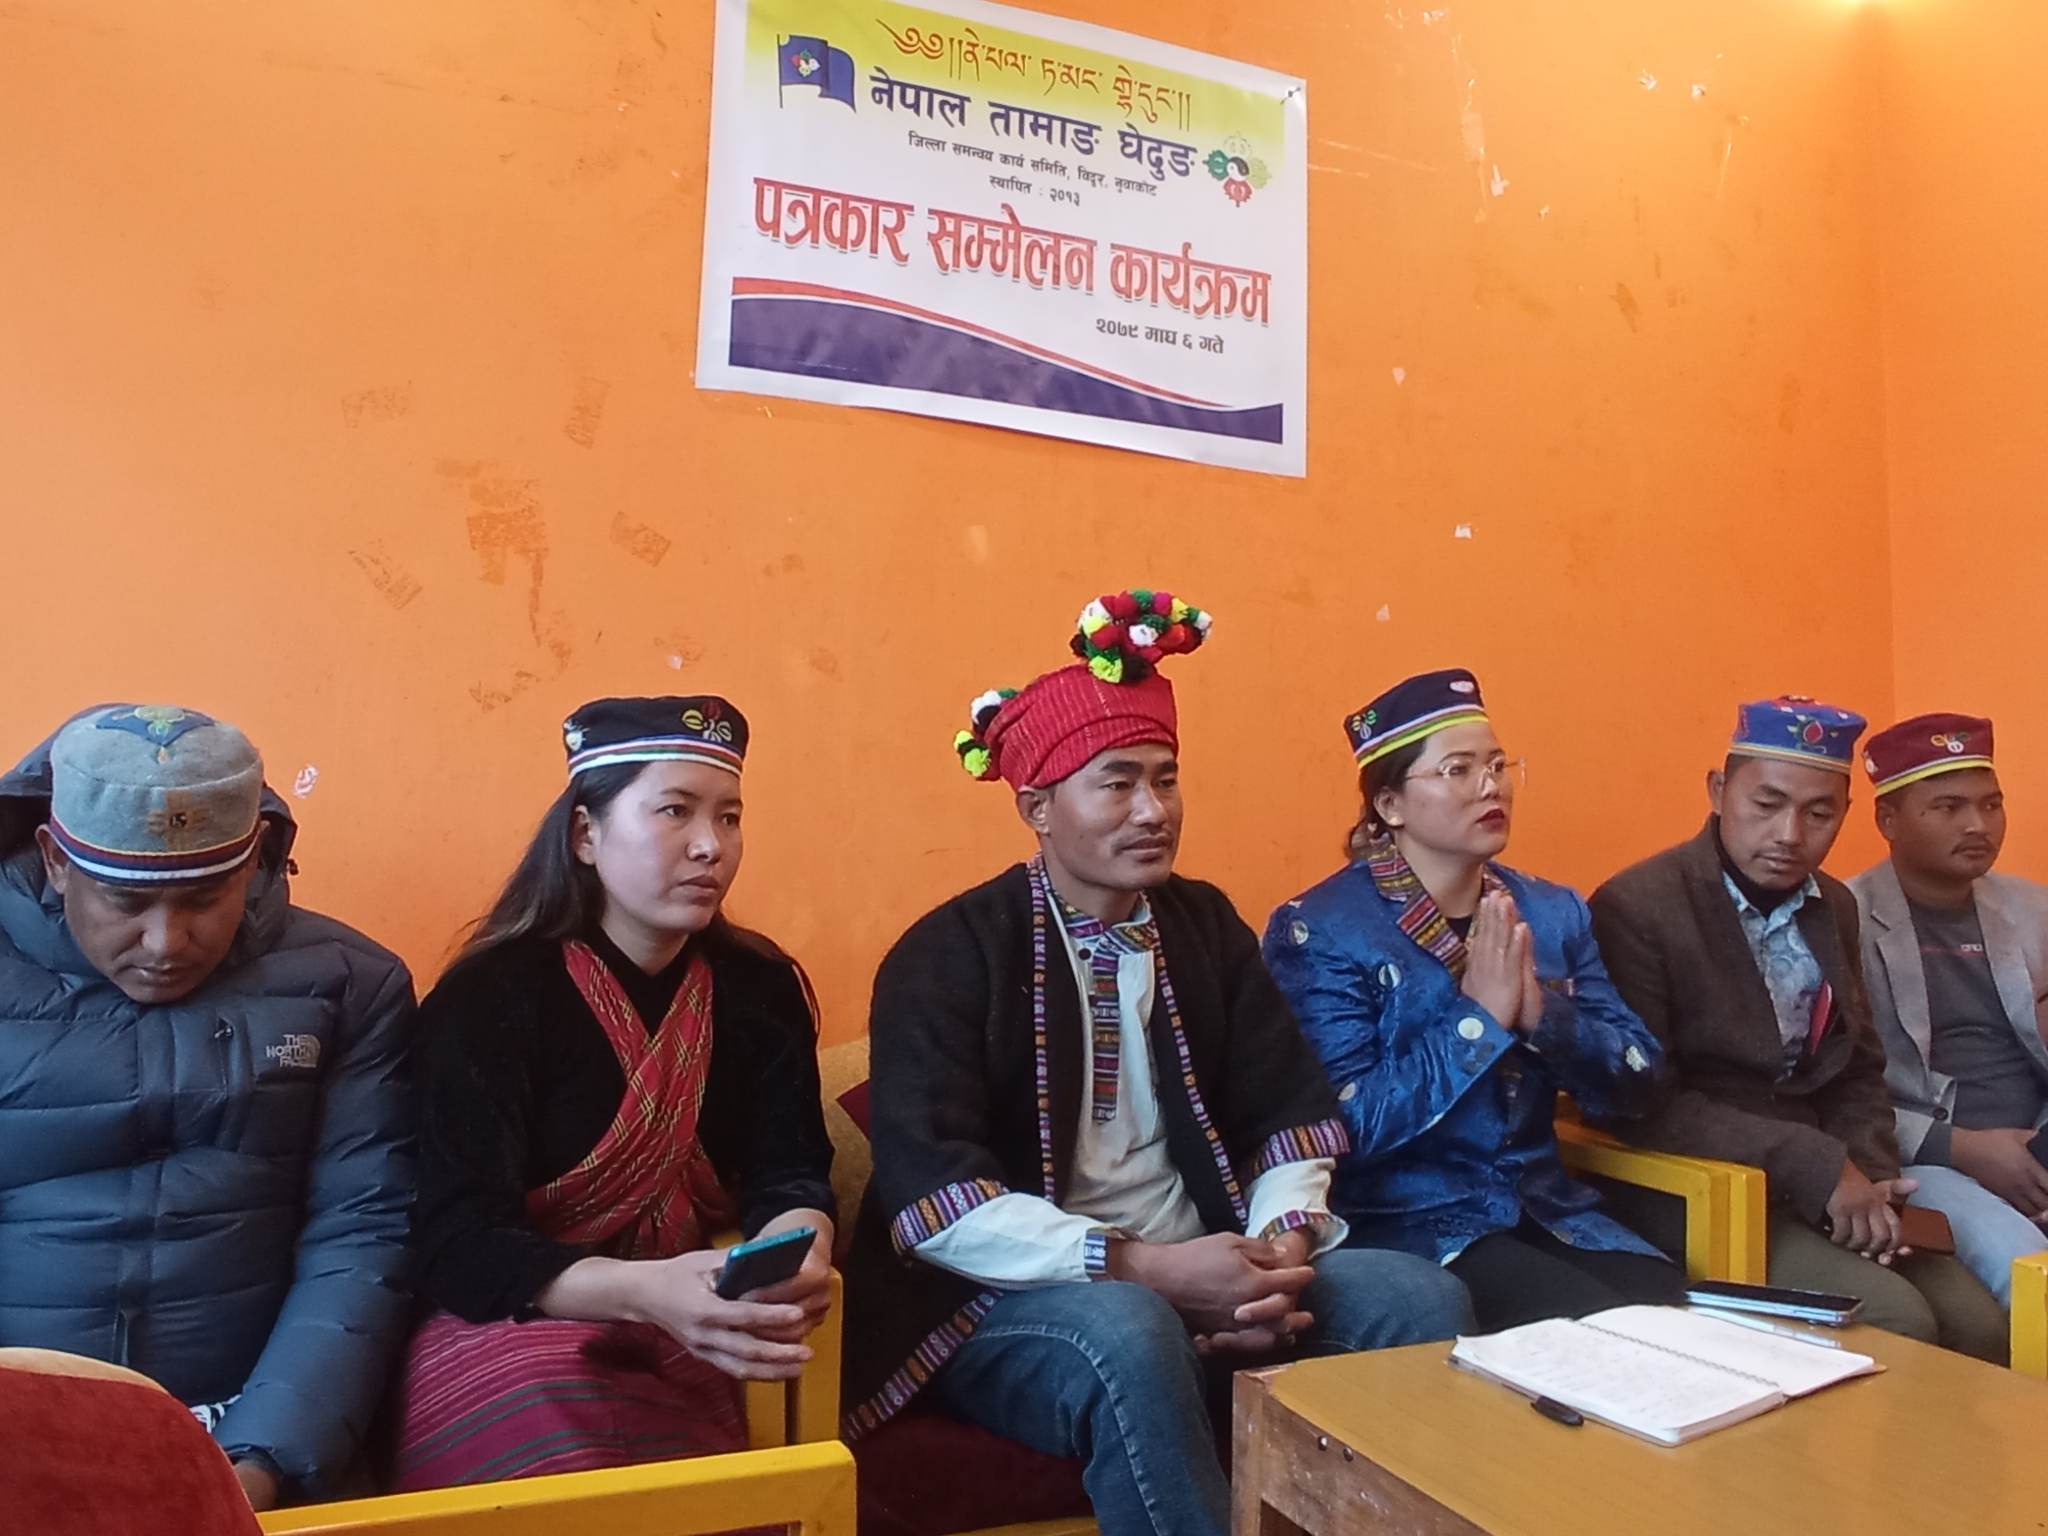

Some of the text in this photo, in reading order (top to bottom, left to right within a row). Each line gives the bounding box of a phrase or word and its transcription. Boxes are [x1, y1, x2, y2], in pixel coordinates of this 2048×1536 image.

[870, 65, 1198, 181] नेपाल तामाङ घेदुङ
[908, 130, 947, 153] जिल्ला
[951, 142, 994, 163] समन्वय
[989, 174, 1033, 194] स्थापित
[1050, 187, 1081, 207] २०१३
[753, 177, 1272, 326] पत्रकार सम्मेलन कार्यक्रम
[1096, 318, 1225, 354] २०७९ माघ ६ गते
